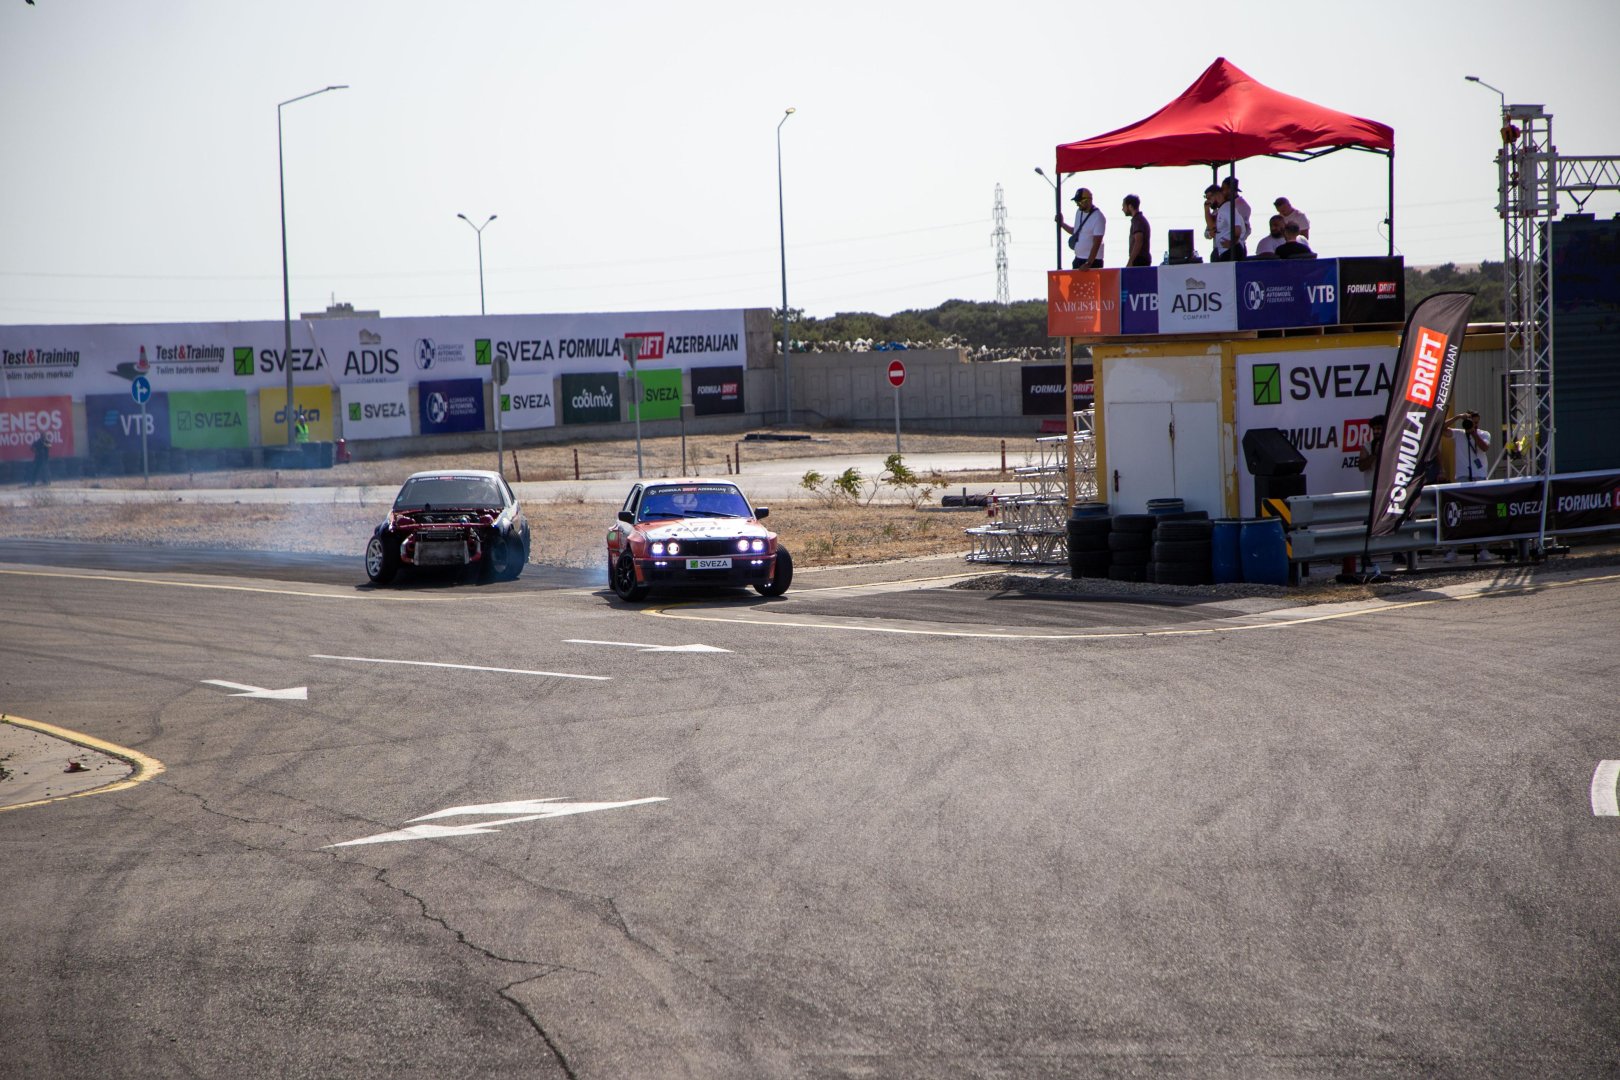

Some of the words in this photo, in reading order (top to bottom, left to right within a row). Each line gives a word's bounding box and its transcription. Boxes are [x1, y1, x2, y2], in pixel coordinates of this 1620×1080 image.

[1307, 285, 1335, 304] VTB
[1347, 284, 1377, 294] FORMULA
[1378, 282, 1396, 293] DRIFT
[1129, 293, 1159, 312] VTB
[1171, 292, 1222, 314] ADIS
[3, 347, 80, 367] Test&Training
[156, 344, 224, 363] Test&Training
[496, 339, 554, 362] SVEZA
[558, 336, 620, 359] FORMULA
[666, 333, 738, 354] AZERBAIJAN
[344, 348, 399, 376] ADIS
[1073, 383, 1094, 392] DRIFT
[1290, 362, 1391, 401] SVEZA
[1435, 344, 1458, 412] AZERBAIJAN
[645, 387, 679, 402] SVEZA
[697, 385, 721, 395] FORMULA
[365, 402, 406, 419] SVEZA
[513, 394, 551, 410] SVEZA
[0, 410, 62, 433] ENEOS
[121, 413, 155, 436] VTB
[194, 412, 242, 429] SVEZA
[1387, 411, 1427, 515] FORMULA
[1411, 332, 1441, 402] DRIFT
[46, 430, 63, 444] OIL
[1558, 492, 1611, 512] FORMULA
[700, 560, 728, 568] SVEZA
